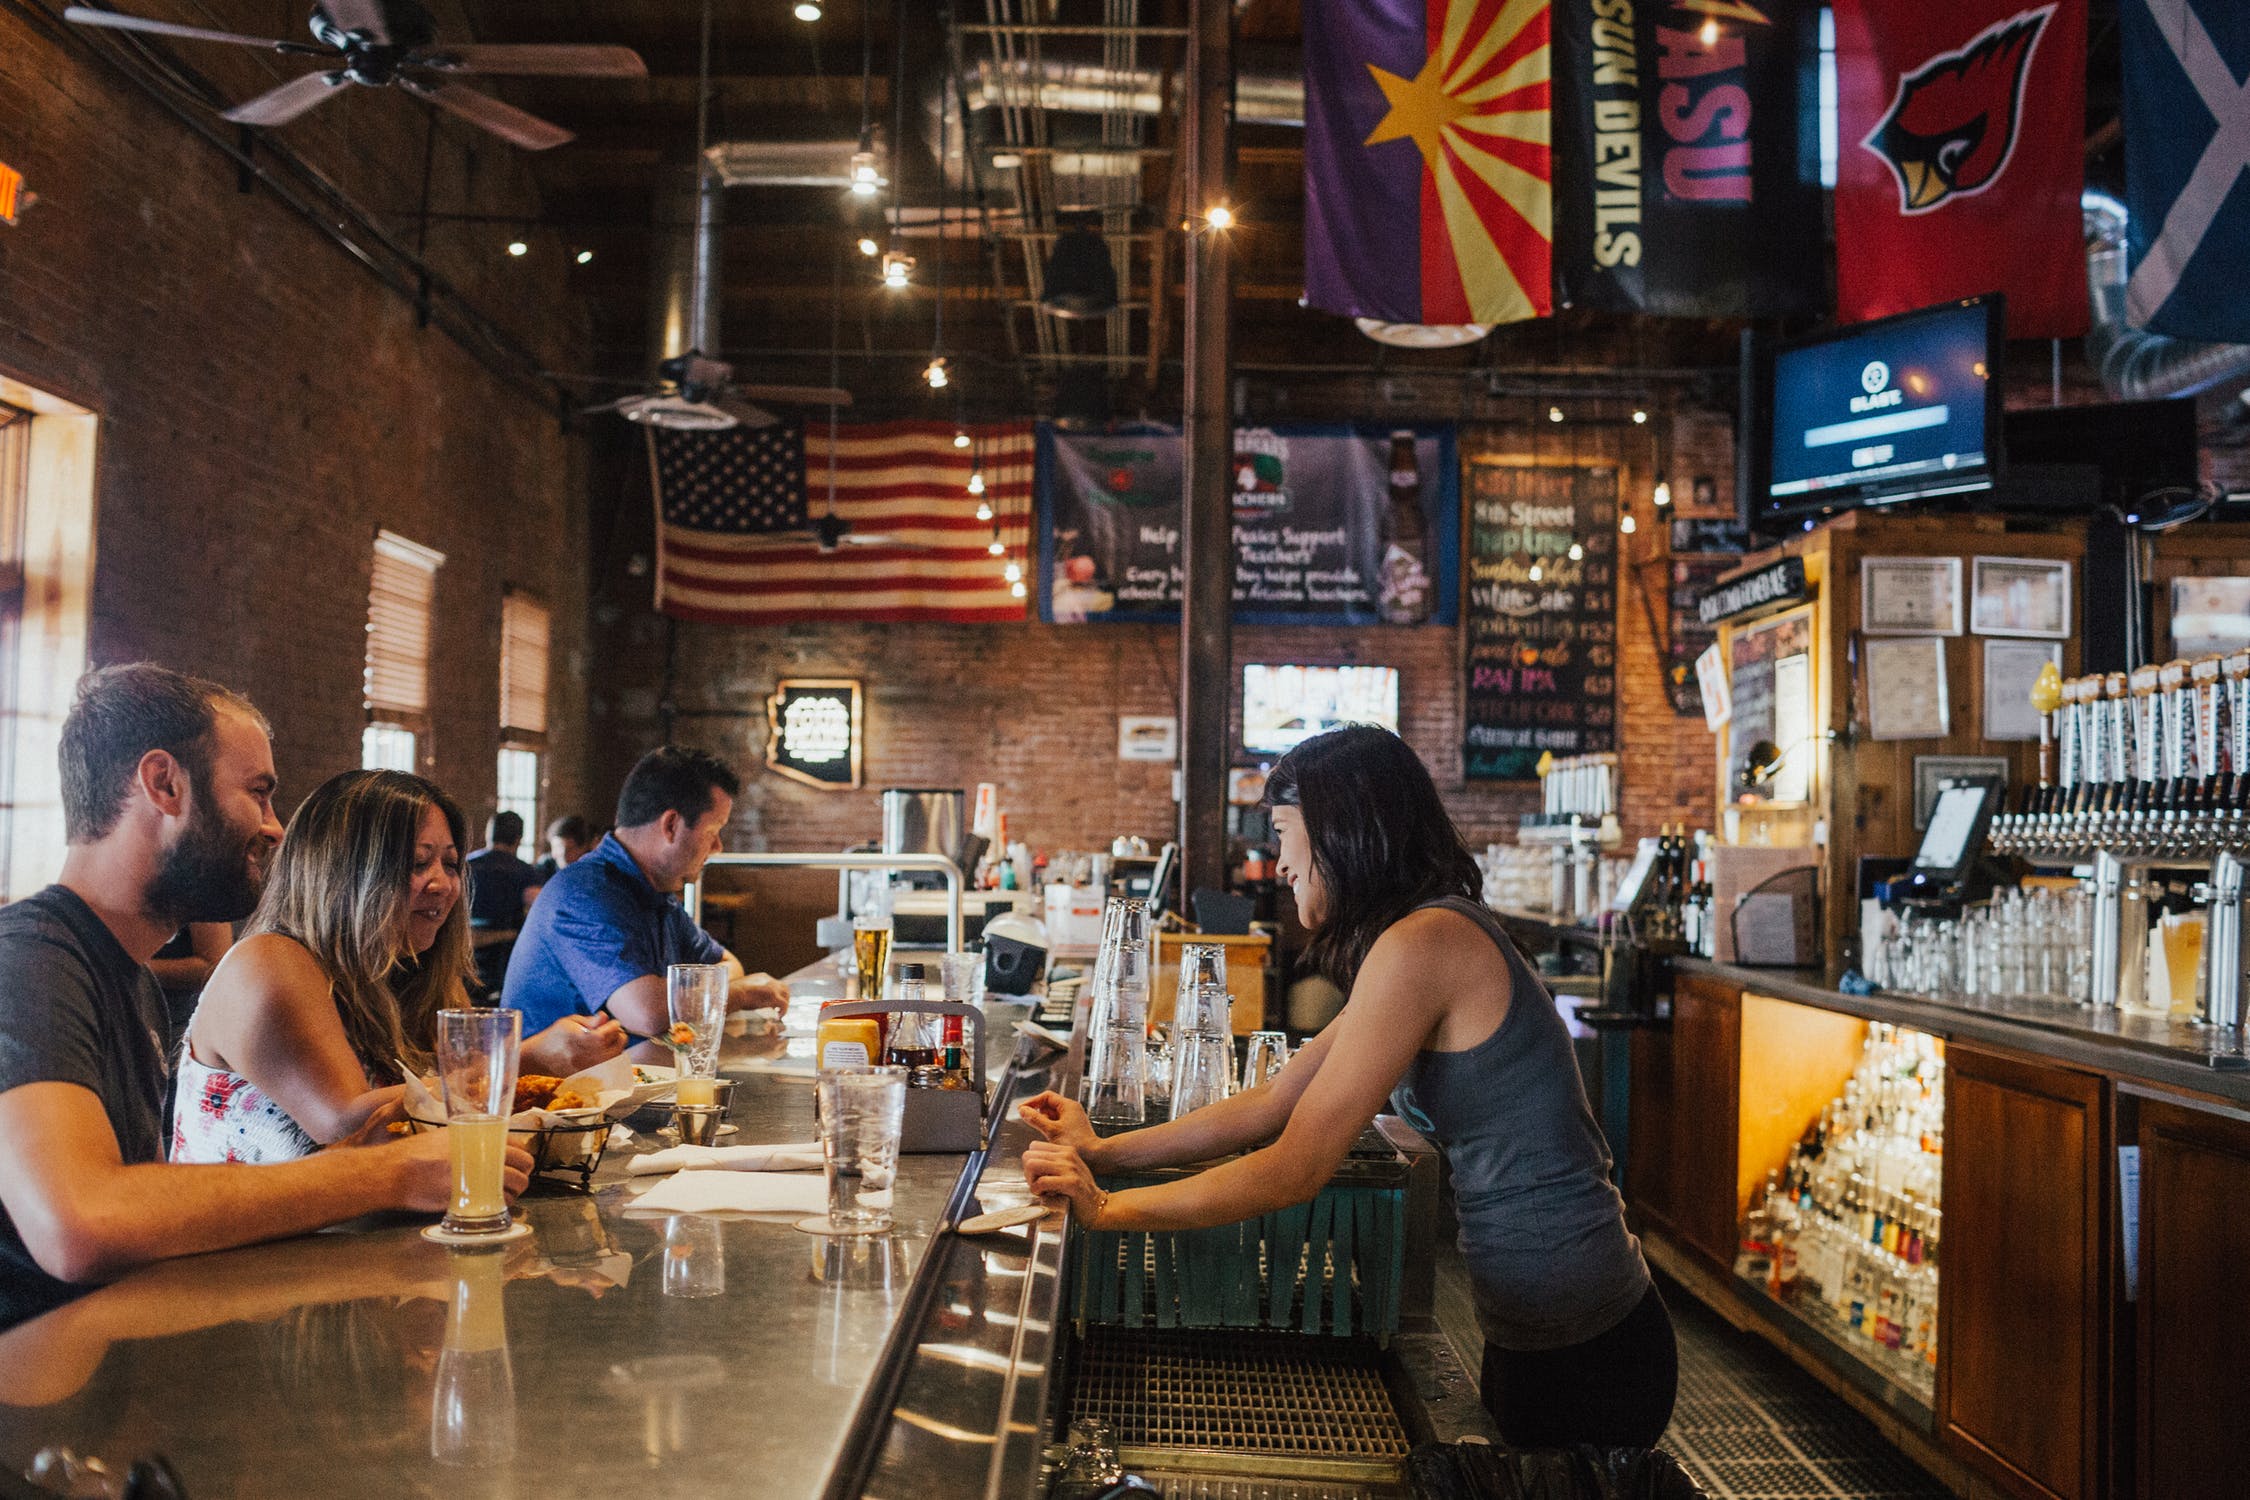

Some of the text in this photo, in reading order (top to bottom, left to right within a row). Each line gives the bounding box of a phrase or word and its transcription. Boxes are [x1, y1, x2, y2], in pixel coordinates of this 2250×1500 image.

[1655, 24, 1753, 201] ASU
[1592, 0, 1642, 268] SUN DEVILS
[1509, 501, 1576, 527] Street
[1140, 526, 1178, 553] Help
[1282, 526, 1345, 554] Support
[1240, 545, 1311, 564] Teachers
